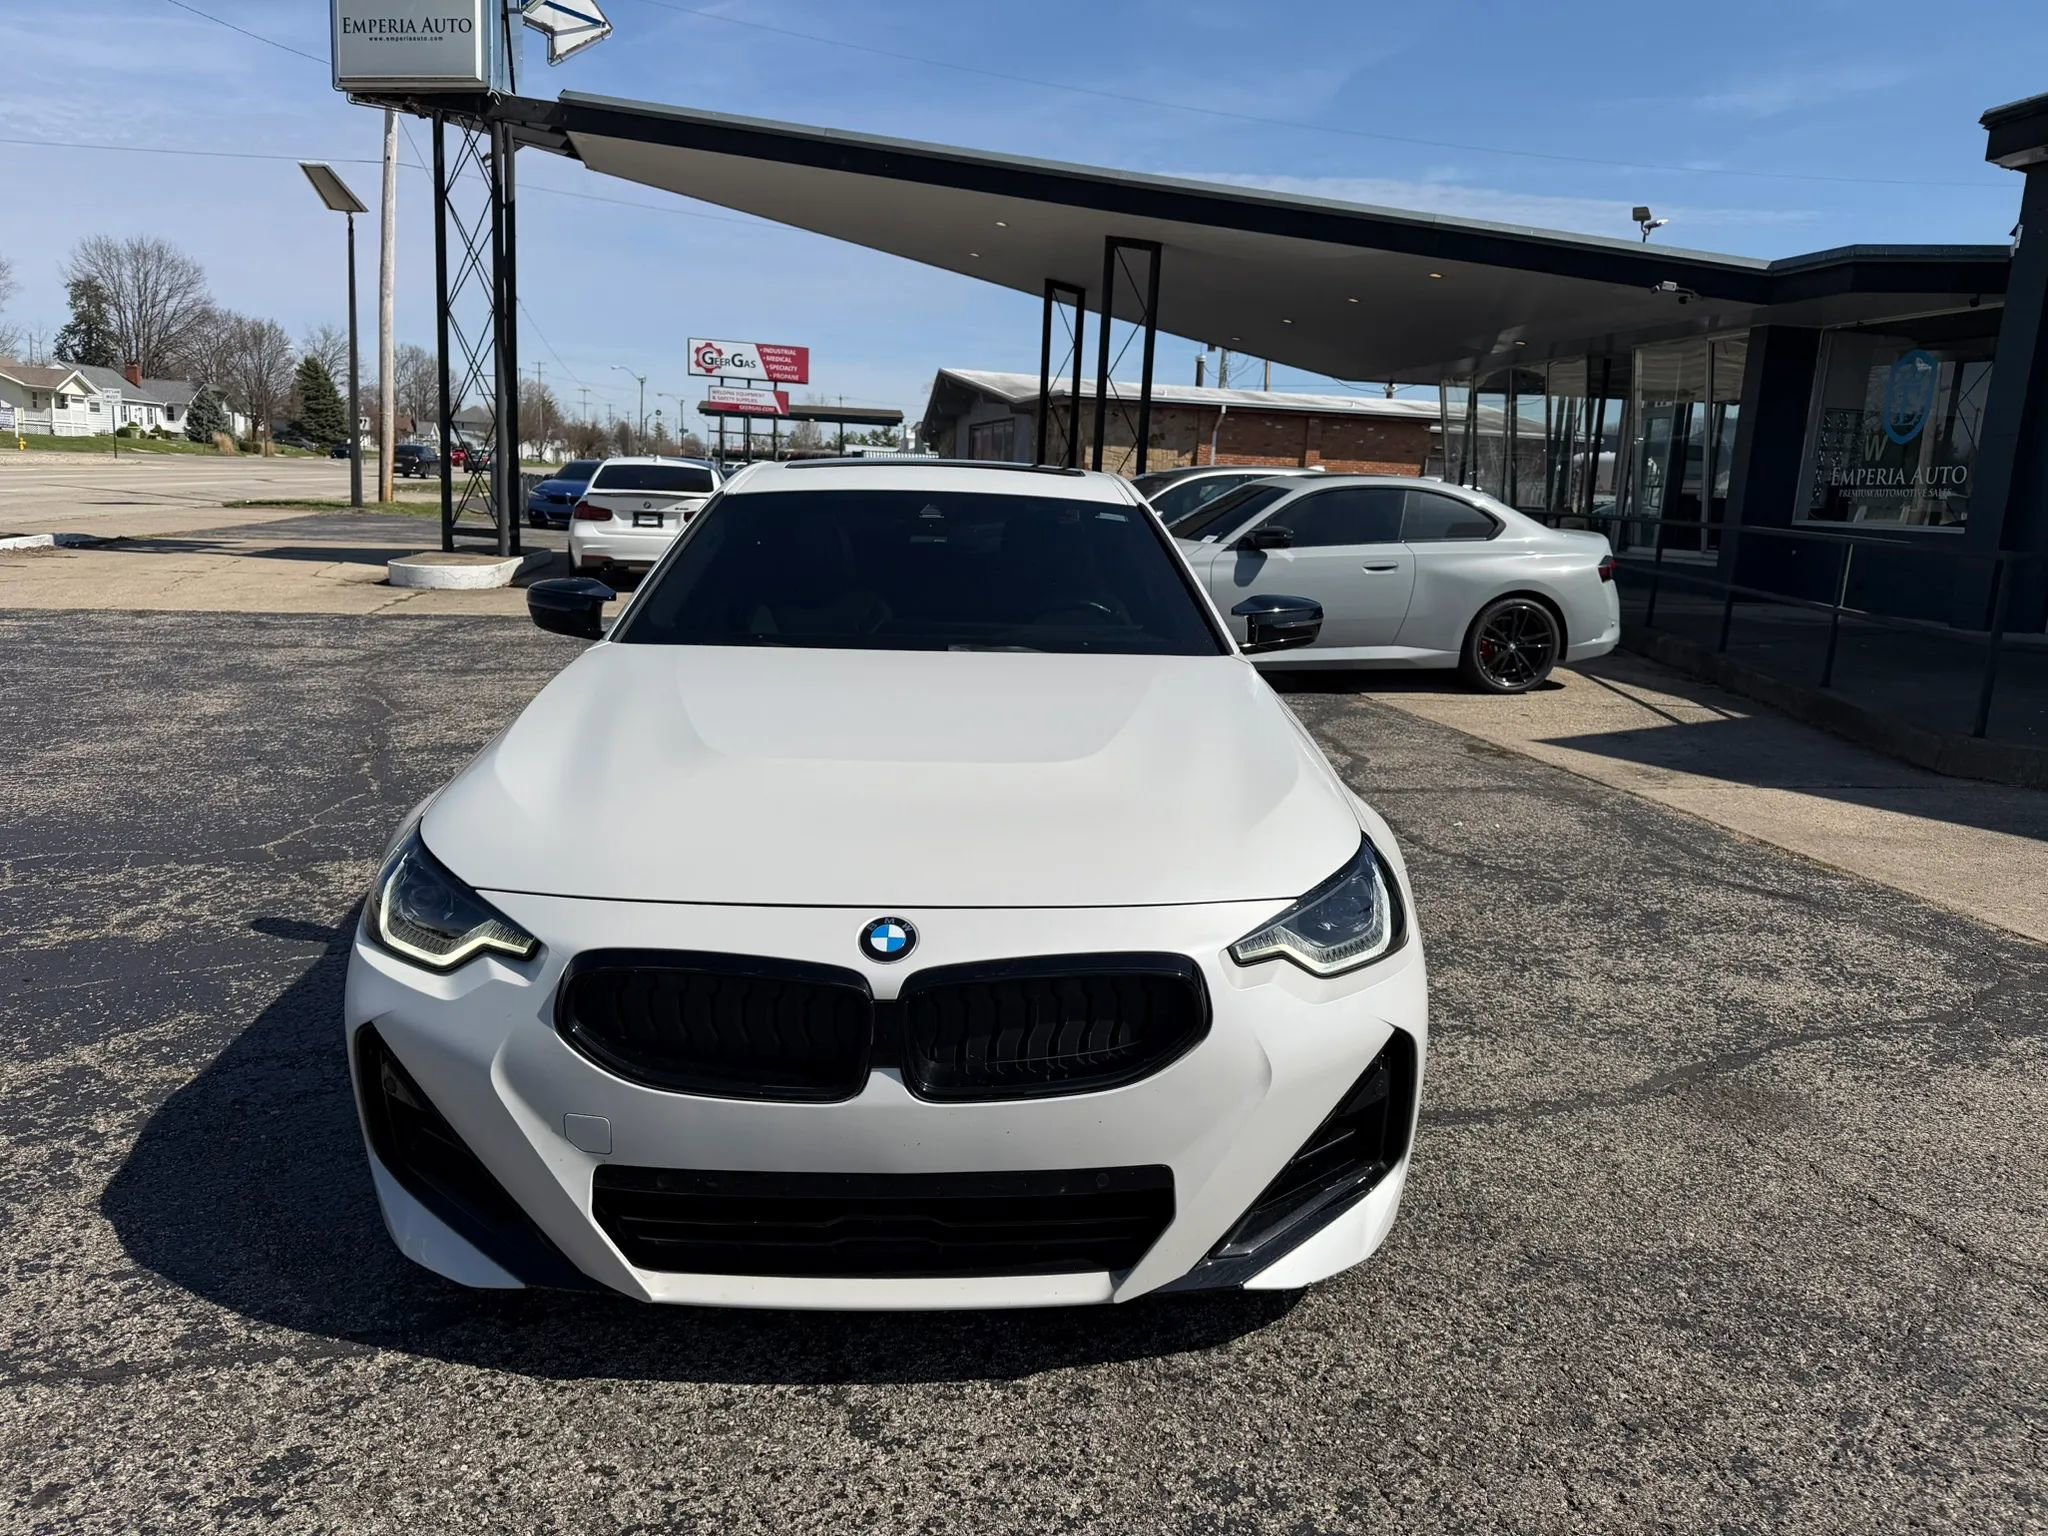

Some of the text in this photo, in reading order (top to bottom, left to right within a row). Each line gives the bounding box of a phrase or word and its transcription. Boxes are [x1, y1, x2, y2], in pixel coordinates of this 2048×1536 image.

[342, 17, 472, 34] EMPERIA AUTO
[763, 347, 796, 356] INDUSTRIAL
[766, 355, 792, 363] MEDICAL
[769, 364, 798, 372] SPECIALTY
[772, 373, 800, 381] PROPANE
[1831, 465, 1968, 486] EMPERIA AUTO
[1839, 489, 1874, 498] PREMIUM
[1875, 488, 1928, 498] AUTOMOTIVE
[866, 918, 913, 932] BMW
